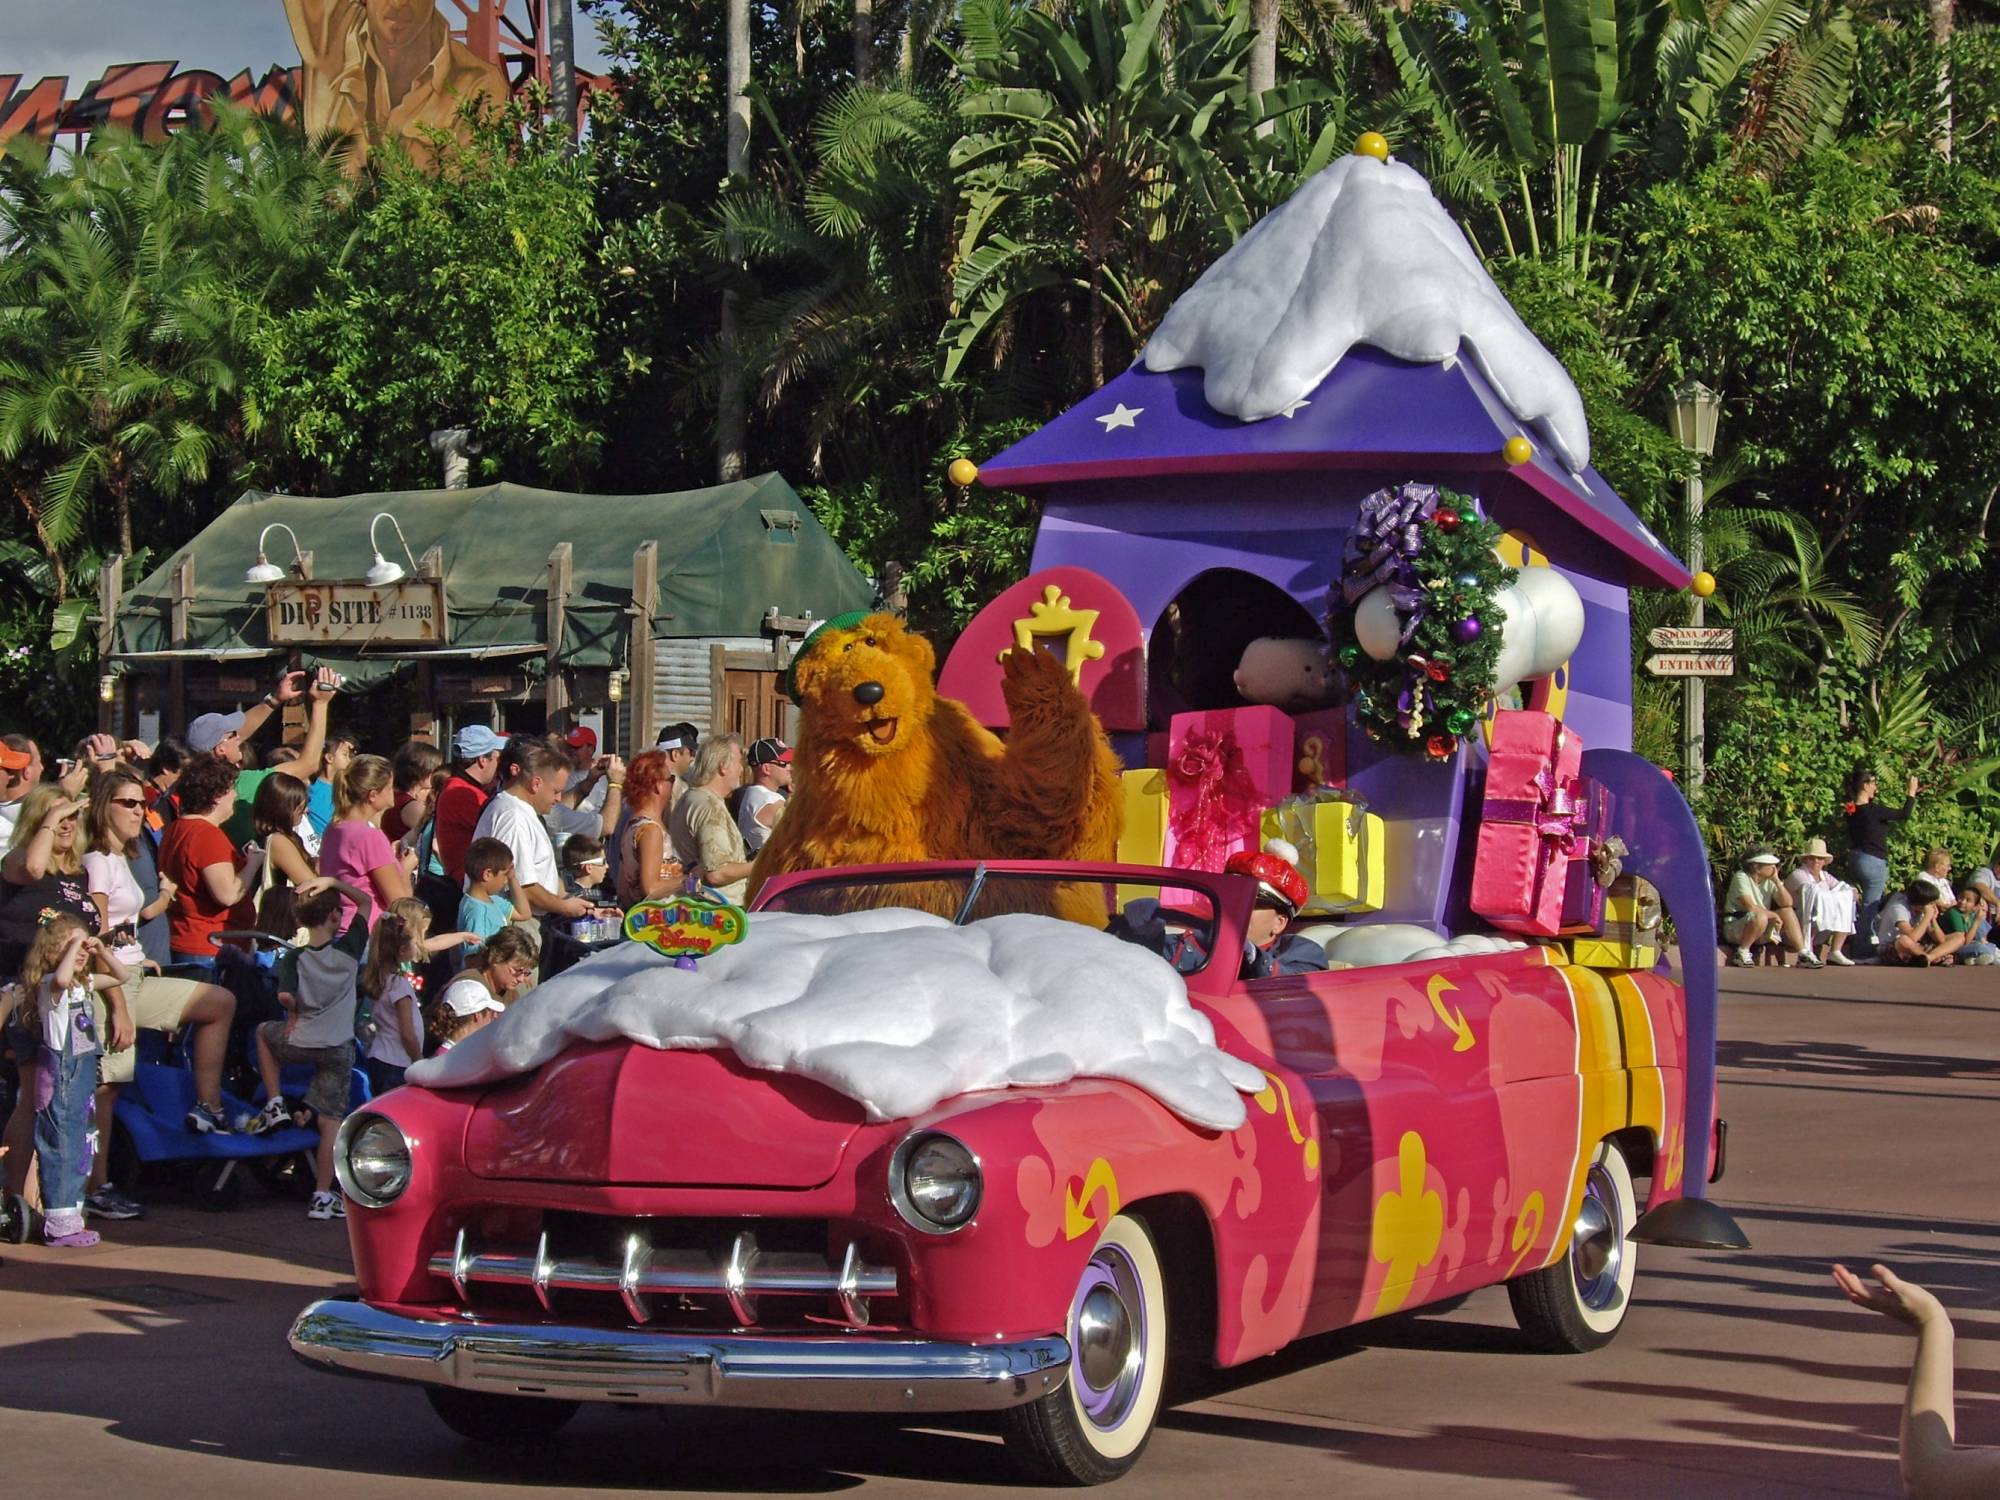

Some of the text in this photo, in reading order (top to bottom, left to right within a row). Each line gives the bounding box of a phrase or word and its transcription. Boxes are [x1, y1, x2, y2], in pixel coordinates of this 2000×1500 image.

[328, 601, 382, 624] SITE
[1659, 660, 1729, 670] ENTRANCE
[631, 905, 736, 932] playhouse
[649, 925, 712, 955] Disney
